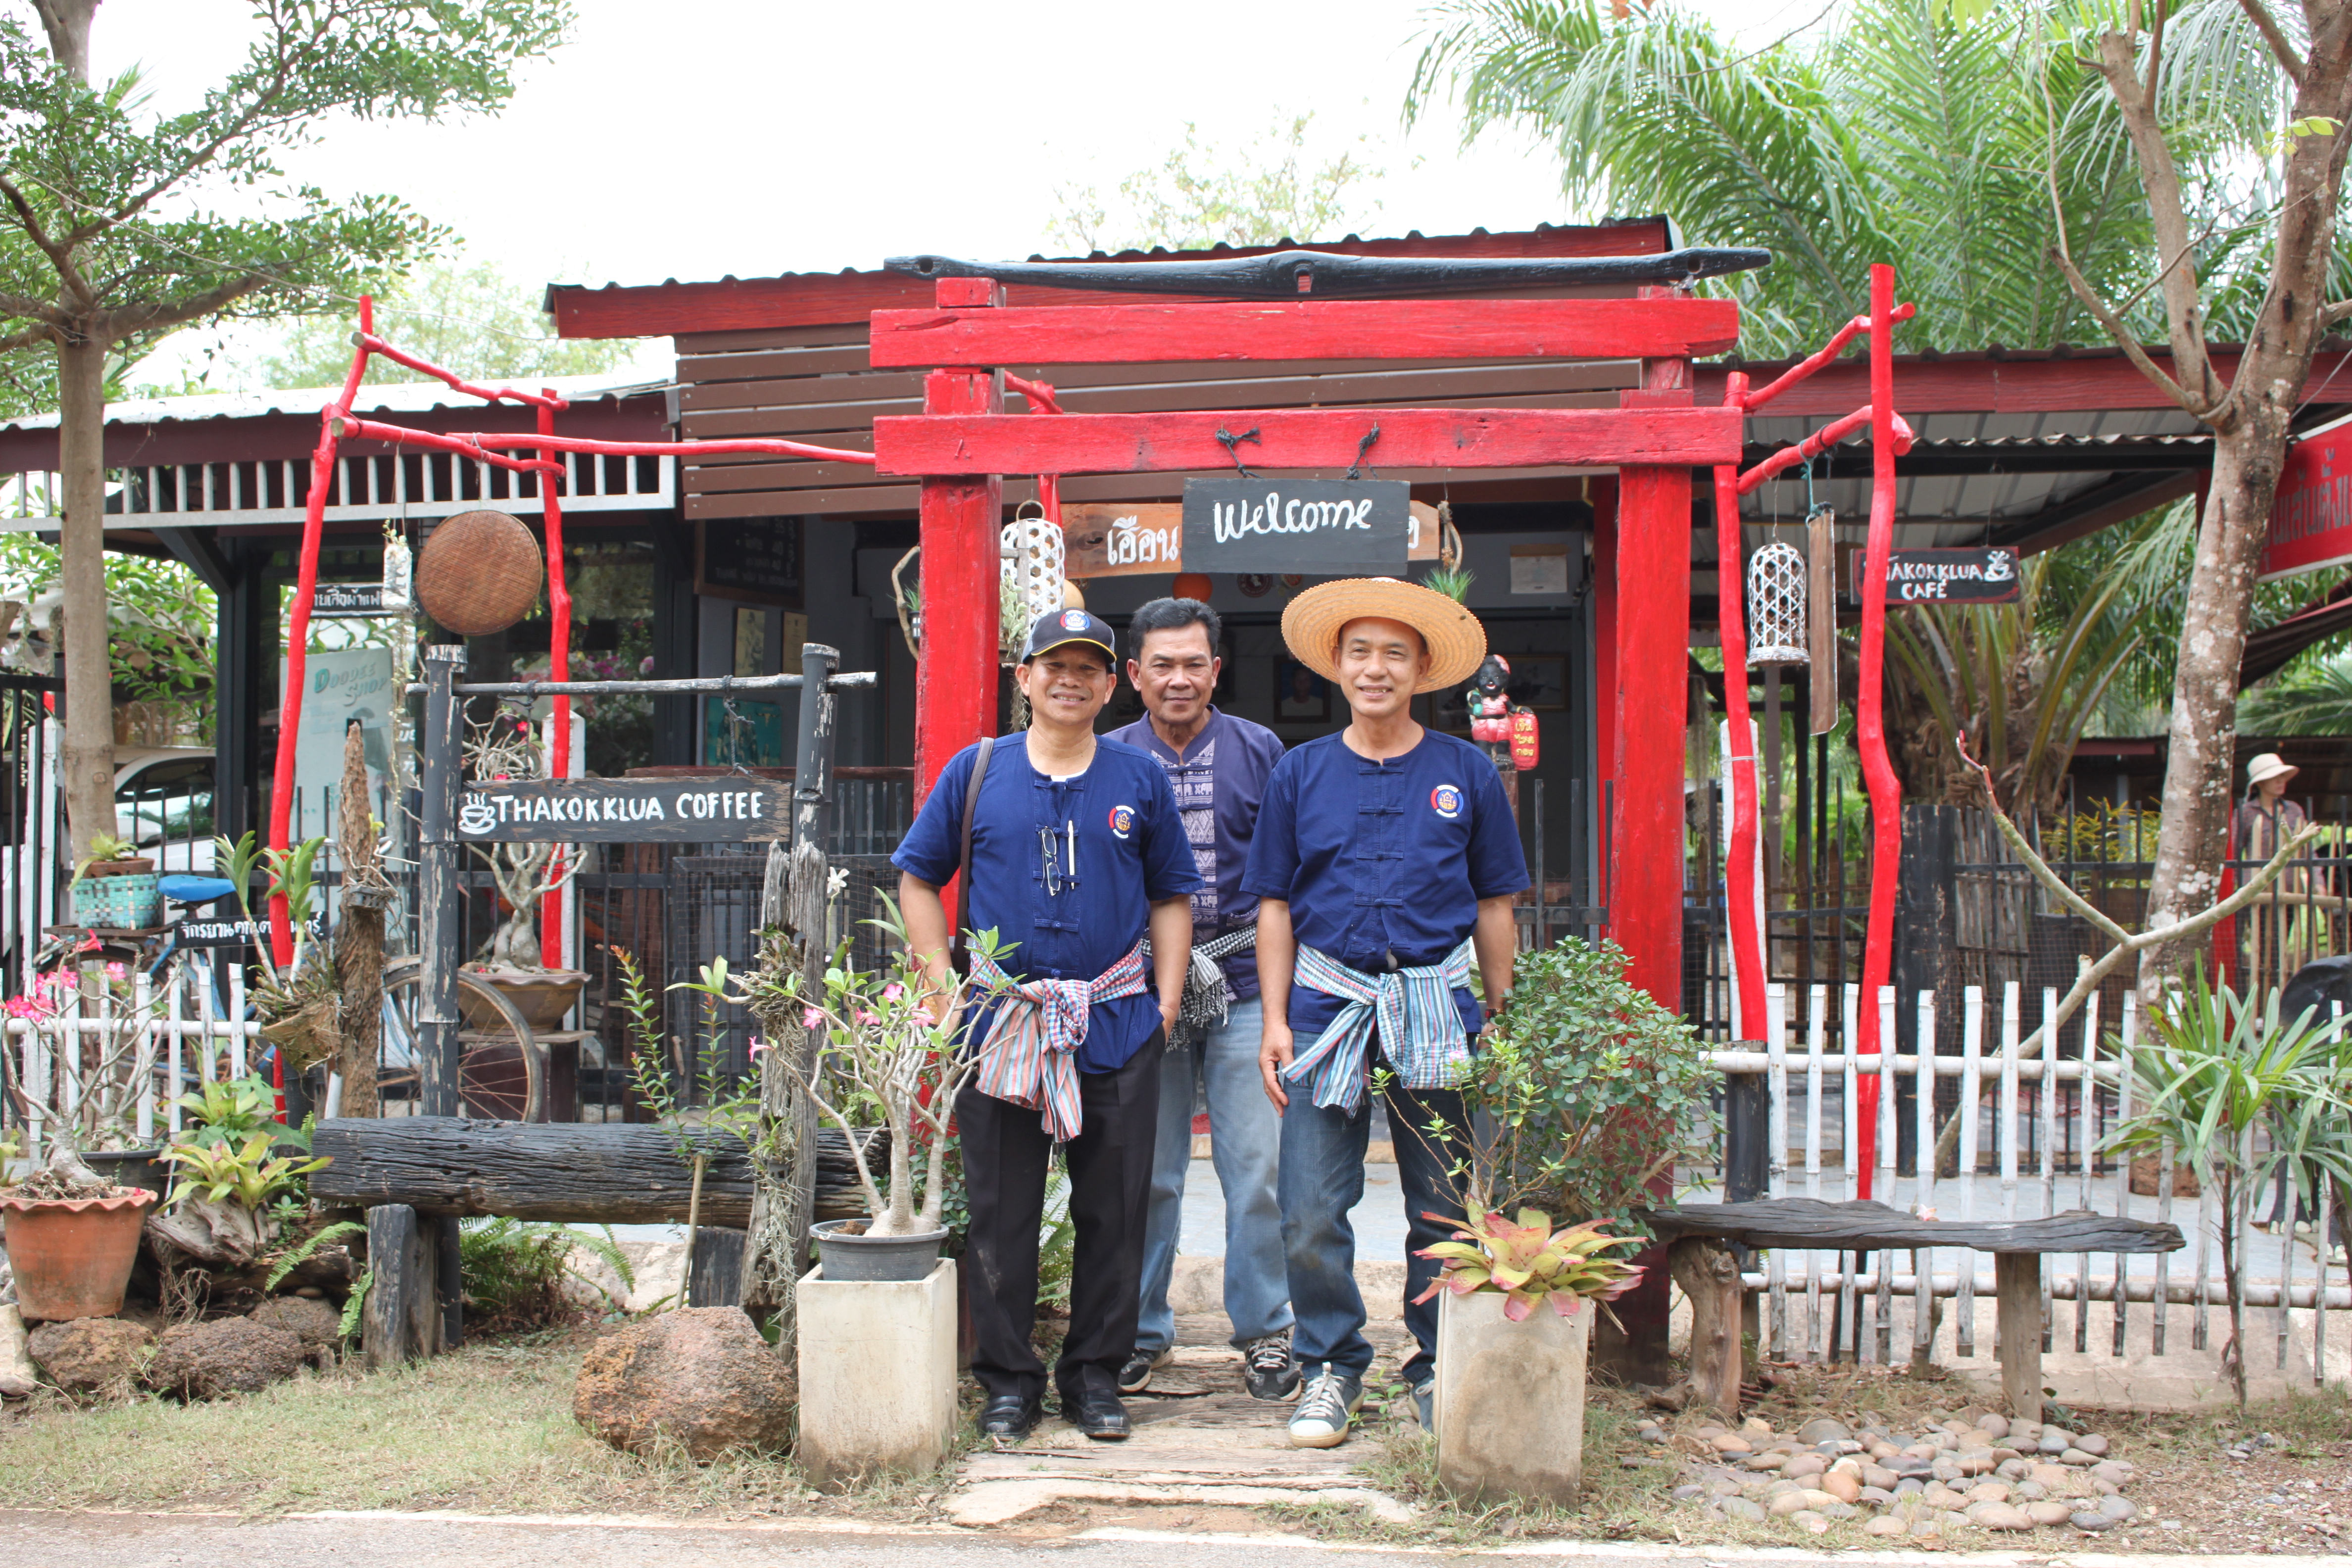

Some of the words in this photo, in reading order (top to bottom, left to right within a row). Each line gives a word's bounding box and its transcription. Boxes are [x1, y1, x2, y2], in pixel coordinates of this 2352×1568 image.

[1107, 515, 1179, 566] เฮือน
[1885, 555, 1983, 581] AKOKKLUA
[491, 794, 665, 823] THAKOKKLUA
[676, 792, 763, 820] COFFEE
